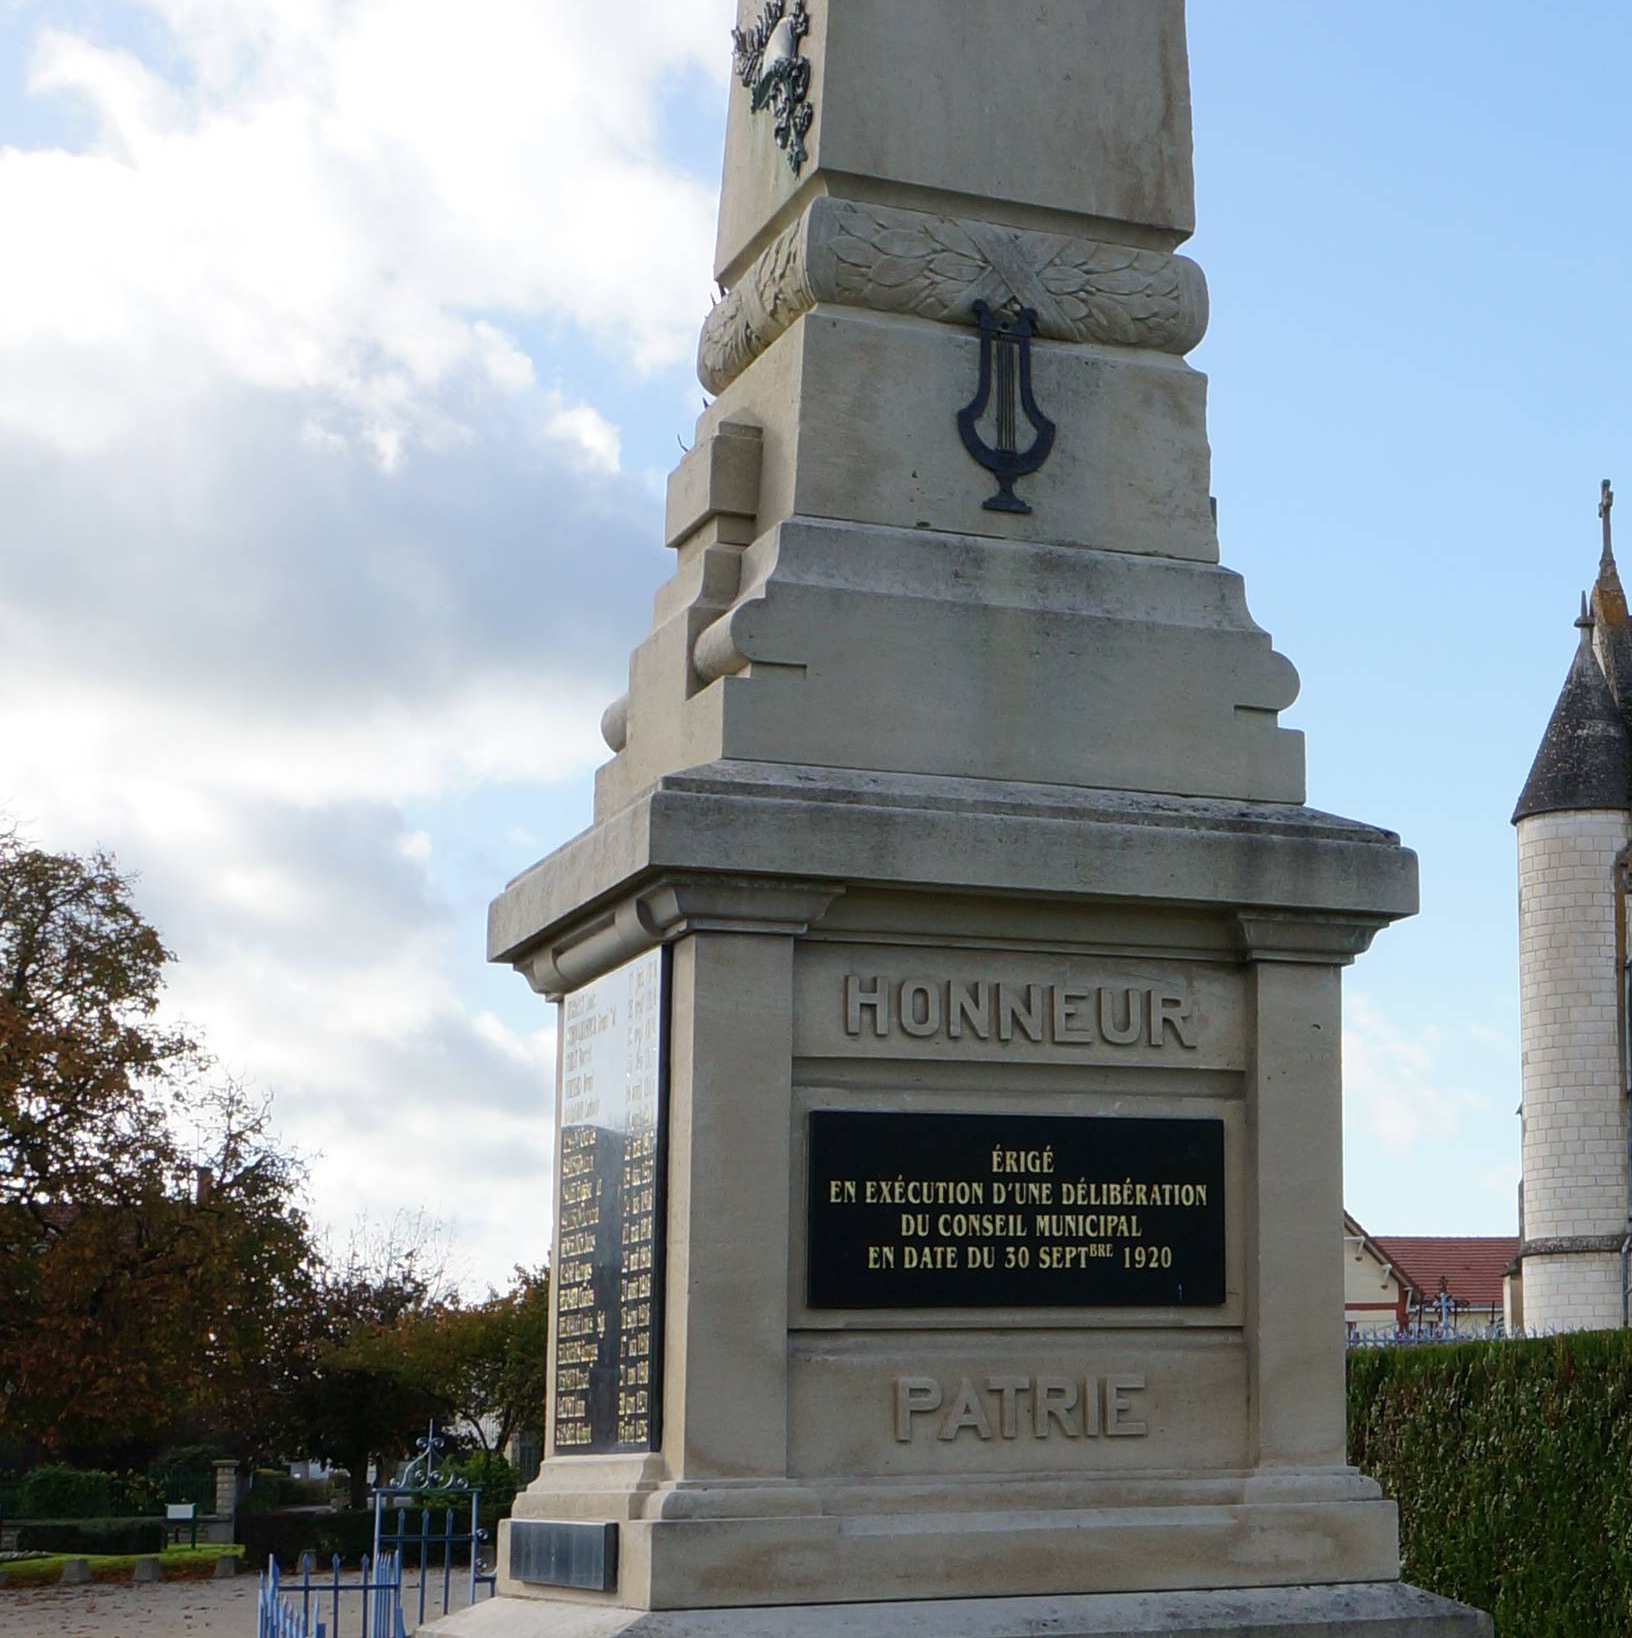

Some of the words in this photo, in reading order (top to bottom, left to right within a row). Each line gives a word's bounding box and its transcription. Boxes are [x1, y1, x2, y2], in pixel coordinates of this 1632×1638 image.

[844, 974, 1198, 1049] HONNEUR
[992, 1144, 1054, 1173] ÉRIGÉ
[829, 1180, 856, 1203] EN
[865, 1174, 984, 1204] EXÉCUTION
[993, 1182, 1053, 1205] D'UNE
[1061, 1176, 1207, 1206] DÉLIBÉRATION
[901, 1214, 929, 1237] DU
[938, 1214, 1027, 1237] CONSEIL
[1036, 1215, 1142, 1238] MUNICIPAL
[868, 1246, 895, 1269] EN
[904, 1246, 958, 1269] DATE
[967, 1246, 995, 1269] DU
[1004, 1246, 1030, 1269] 30
[1124, 1246, 1172, 1269] 1920
[894, 1374, 1147, 1443] PATRIE
